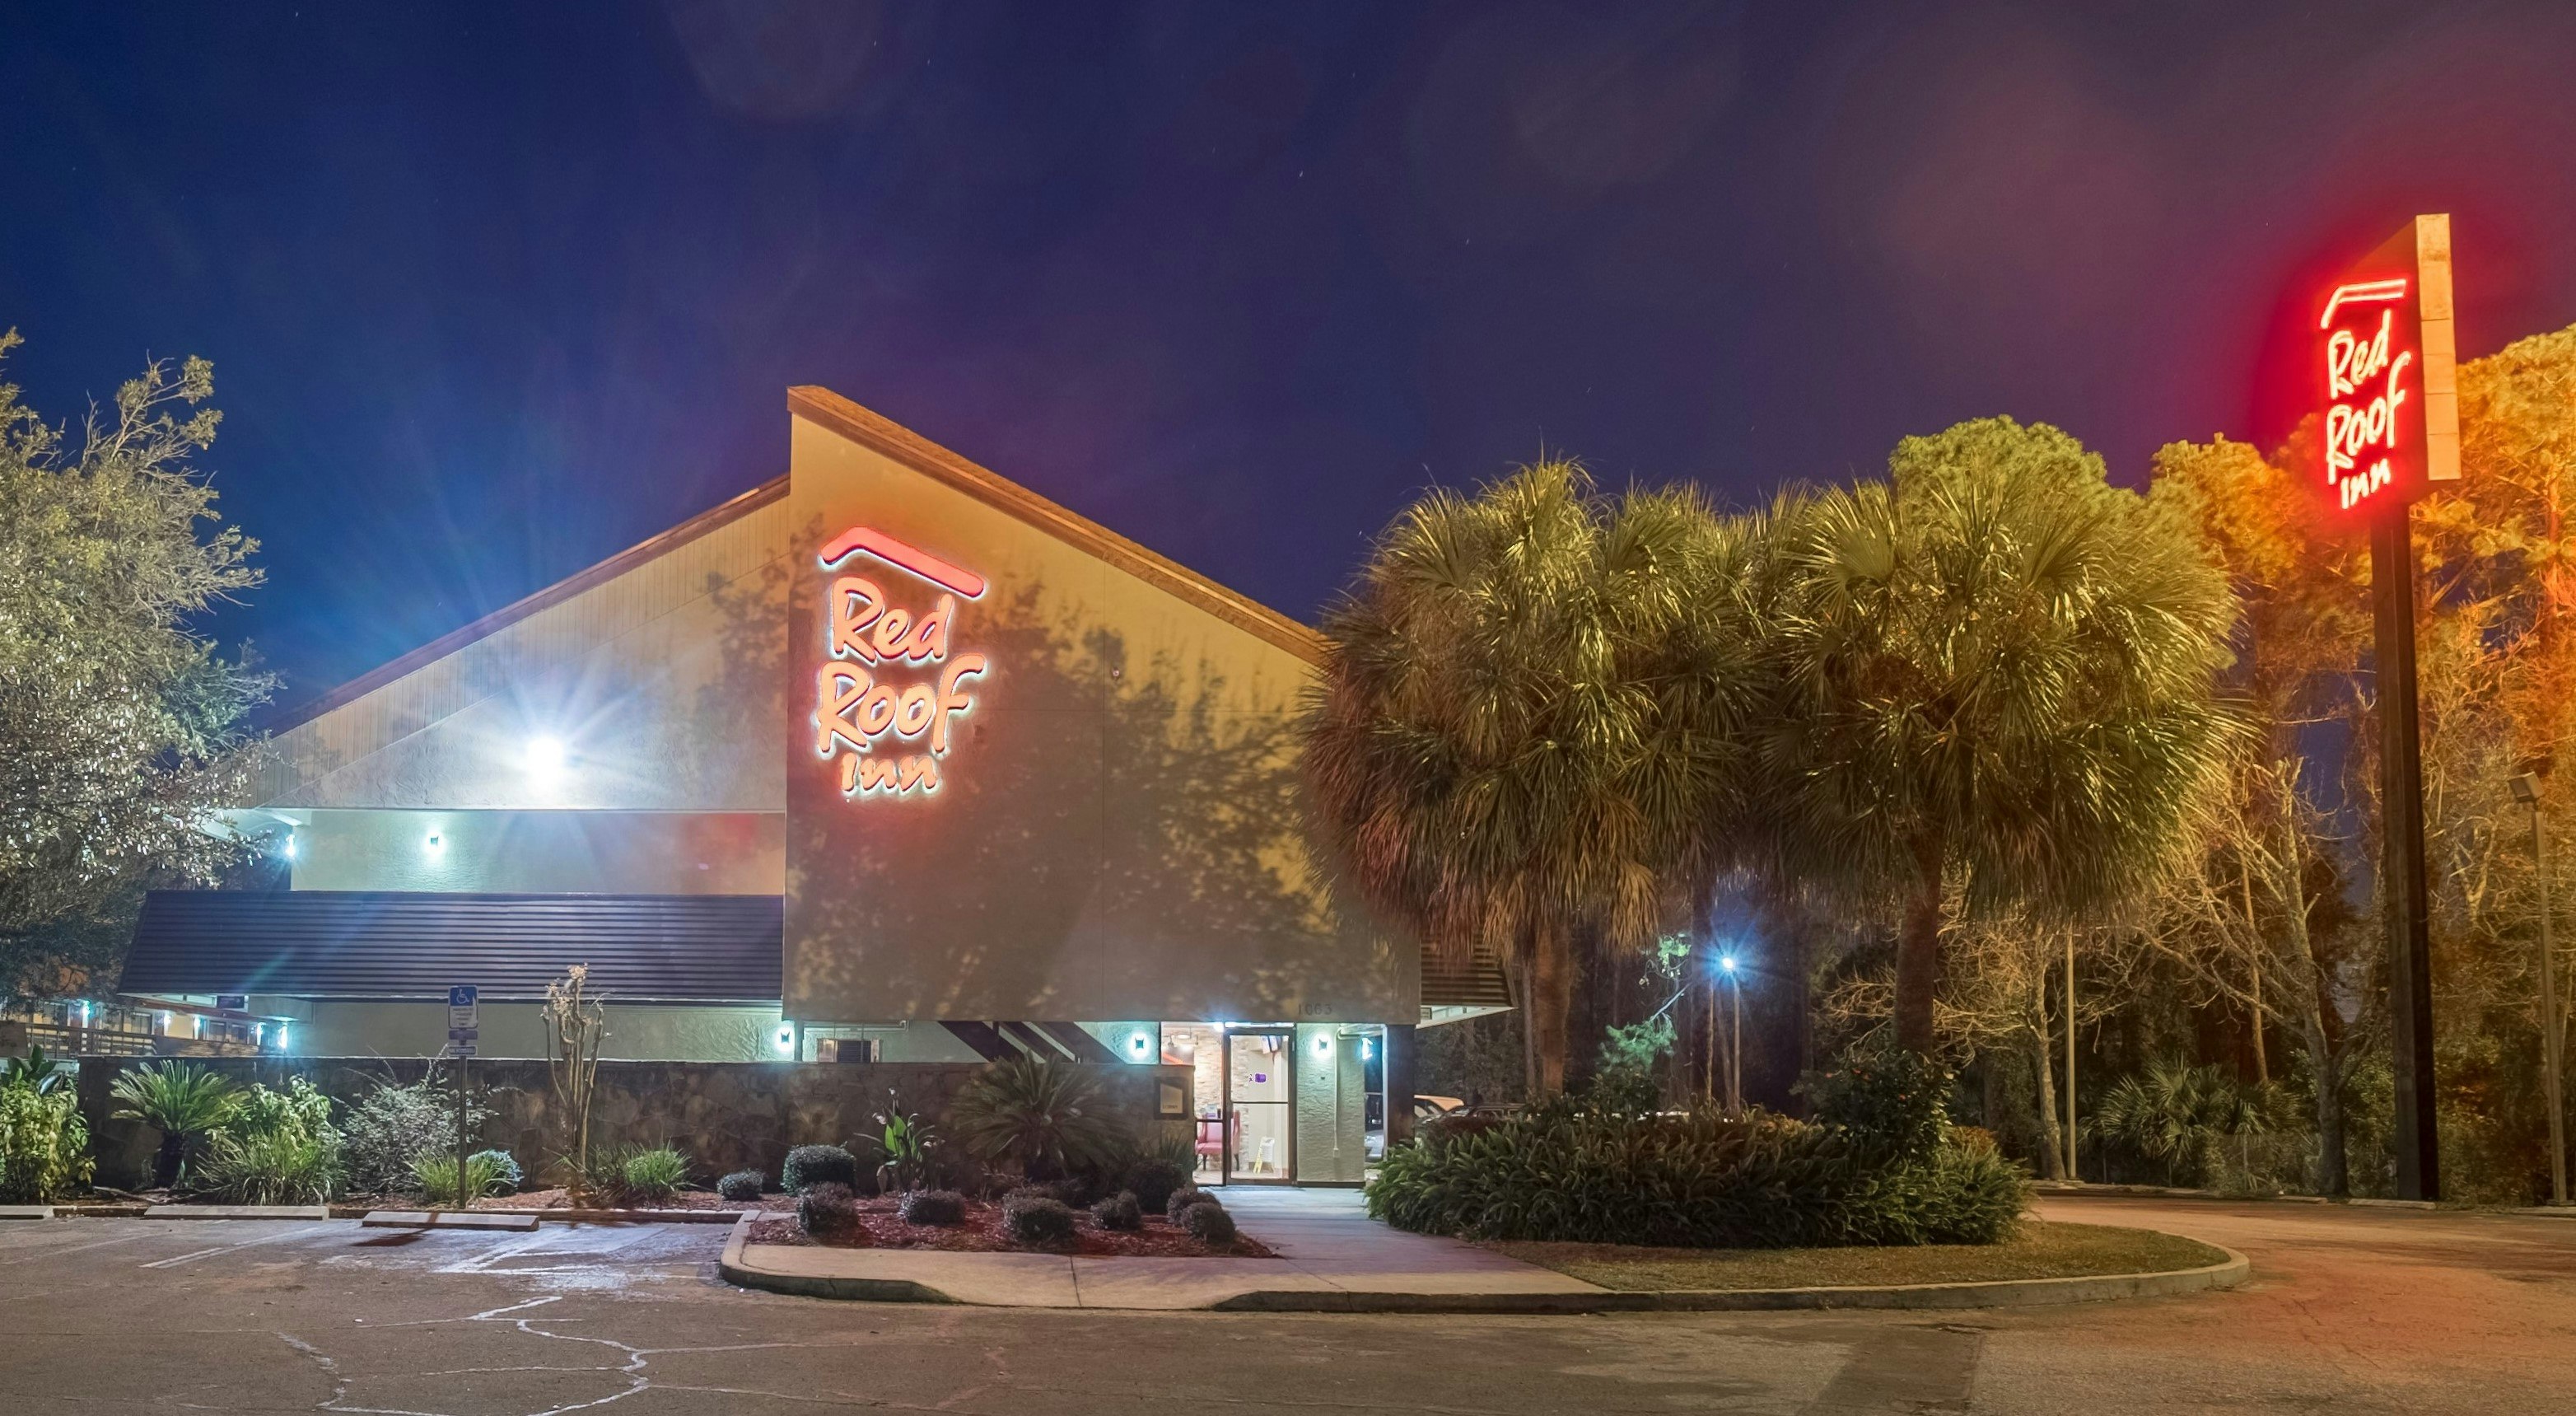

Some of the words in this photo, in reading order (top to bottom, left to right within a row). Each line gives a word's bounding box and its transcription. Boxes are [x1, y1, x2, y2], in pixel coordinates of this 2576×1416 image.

[2327, 310, 2391, 400] Red
[2326, 351, 2411, 485] Roof
[2340, 458, 2391, 509] Inn
[832, 577, 954, 662] Red
[817, 654, 986, 754] Roof
[842, 752, 938, 792] Inn
